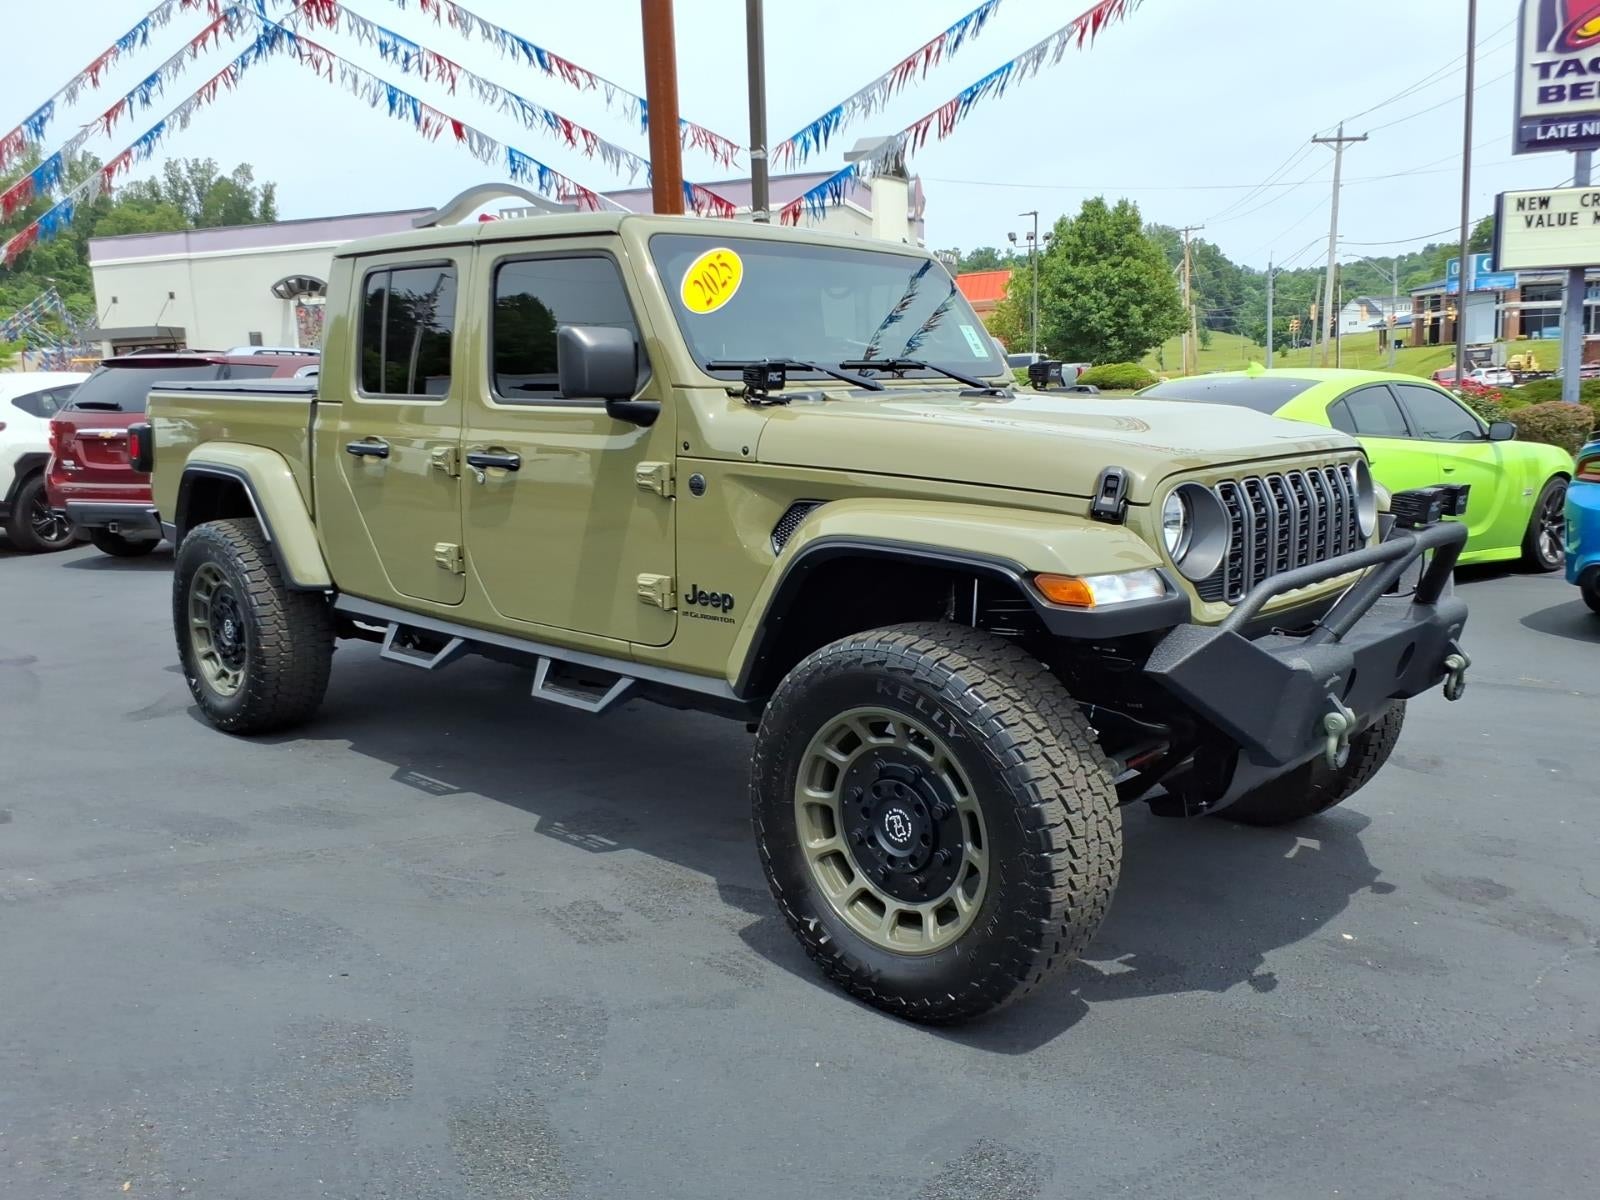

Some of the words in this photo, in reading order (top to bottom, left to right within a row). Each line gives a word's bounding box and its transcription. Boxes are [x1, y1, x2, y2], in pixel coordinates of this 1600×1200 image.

[1537, 80, 1600, 104] BE
[1536, 123, 1578, 140] LATE
[1516, 196, 1551, 211] NEW
[1525, 212, 1579, 228] VALUE
[693, 253, 733, 306] 2025
[684, 583, 735, 614] Jeep
[876, 680, 966, 738] KELLY
